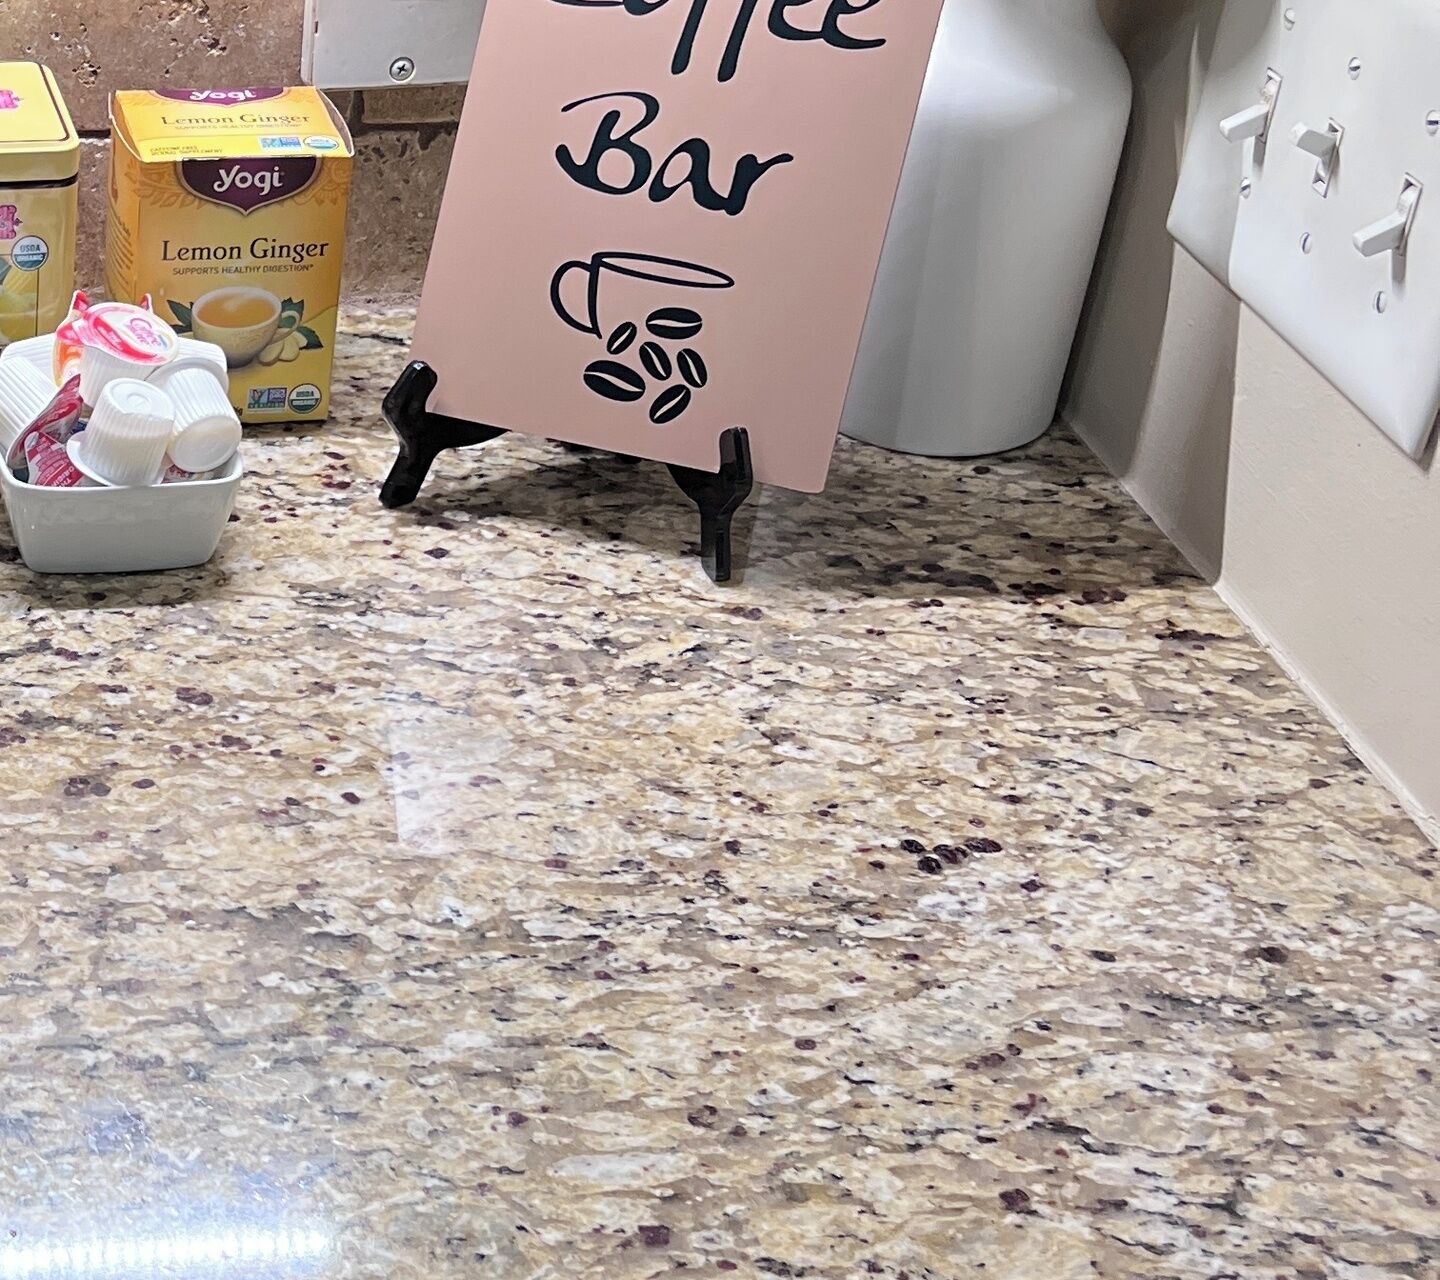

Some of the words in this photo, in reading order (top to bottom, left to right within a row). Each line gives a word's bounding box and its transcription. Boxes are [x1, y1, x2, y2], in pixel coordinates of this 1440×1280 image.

[161, 115, 233, 126] Lemon
[239, 113, 311, 125] Ginger
[555, 91, 793, 216] Bar
[213, 165, 283, 196] yogi
[20, 244, 41, 253] USDA
[161, 240, 241, 261] Lemon
[250, 238, 329, 264] Ginger
[172, 266, 219, 276] SUPPORTS
[221, 266, 261, 274] HEALTHY
